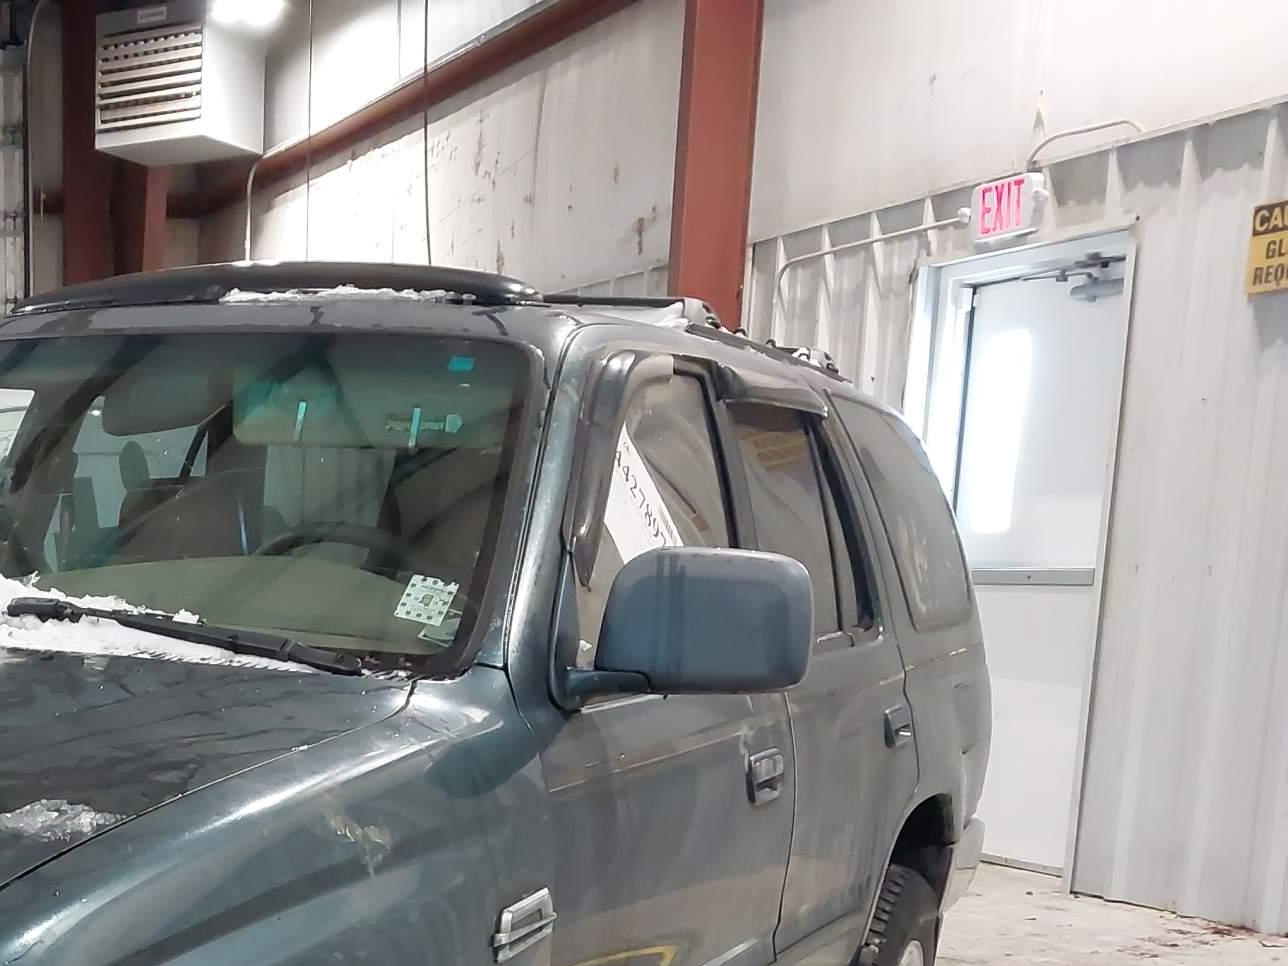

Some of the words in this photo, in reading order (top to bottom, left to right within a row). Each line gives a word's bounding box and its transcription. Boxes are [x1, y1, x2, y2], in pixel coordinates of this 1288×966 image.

[979, 177, 1026, 236] EXIT
[1265, 238, 1288, 259] GL
[1252, 263, 1288, 286] REQ
